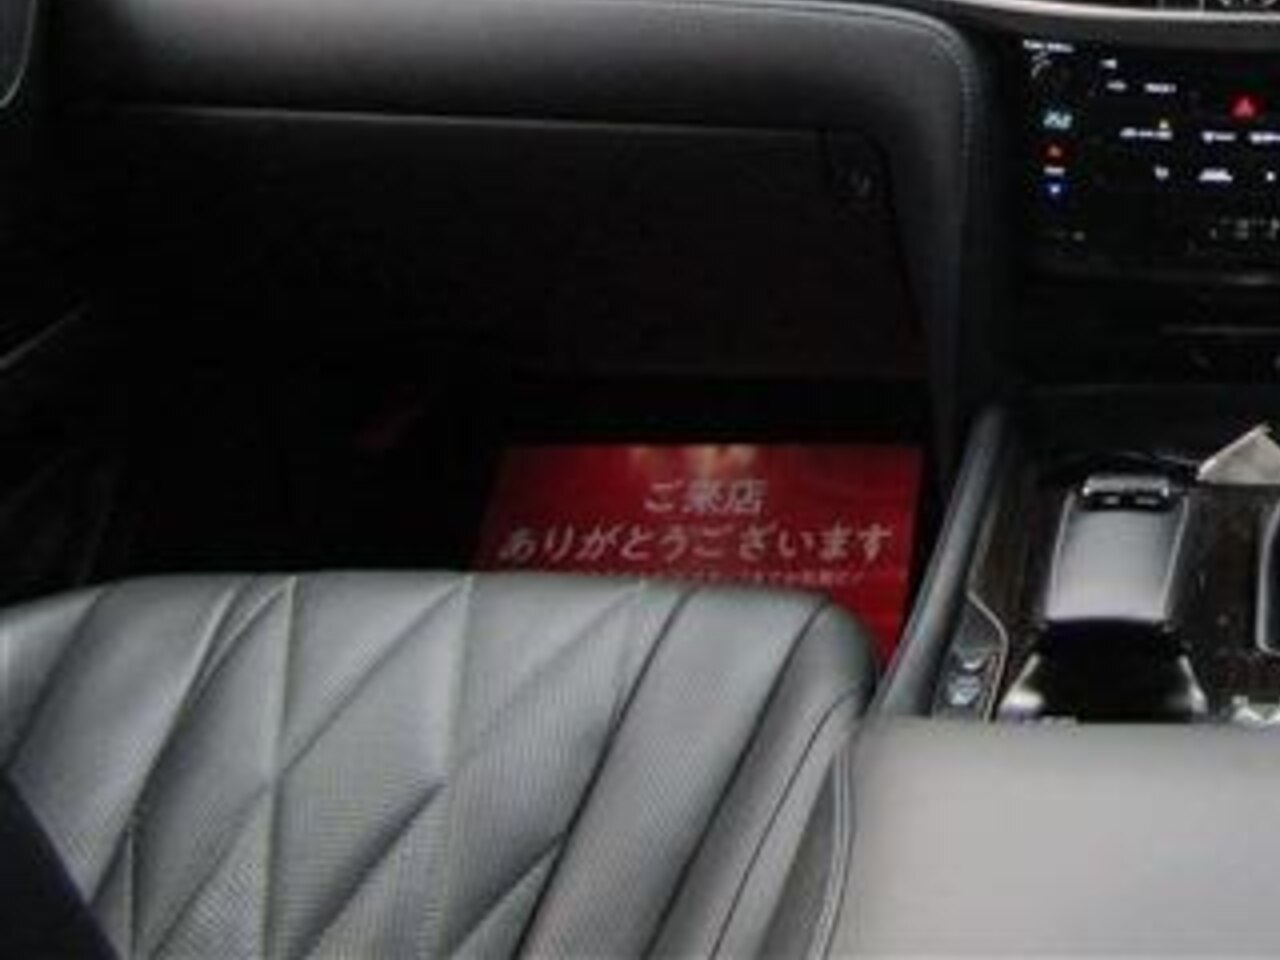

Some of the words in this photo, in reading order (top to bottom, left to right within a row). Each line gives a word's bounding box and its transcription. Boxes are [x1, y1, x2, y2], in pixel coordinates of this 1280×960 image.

[644, 478, 766, 515] ご来店
[502, 521, 893, 563] ありがとうございます
